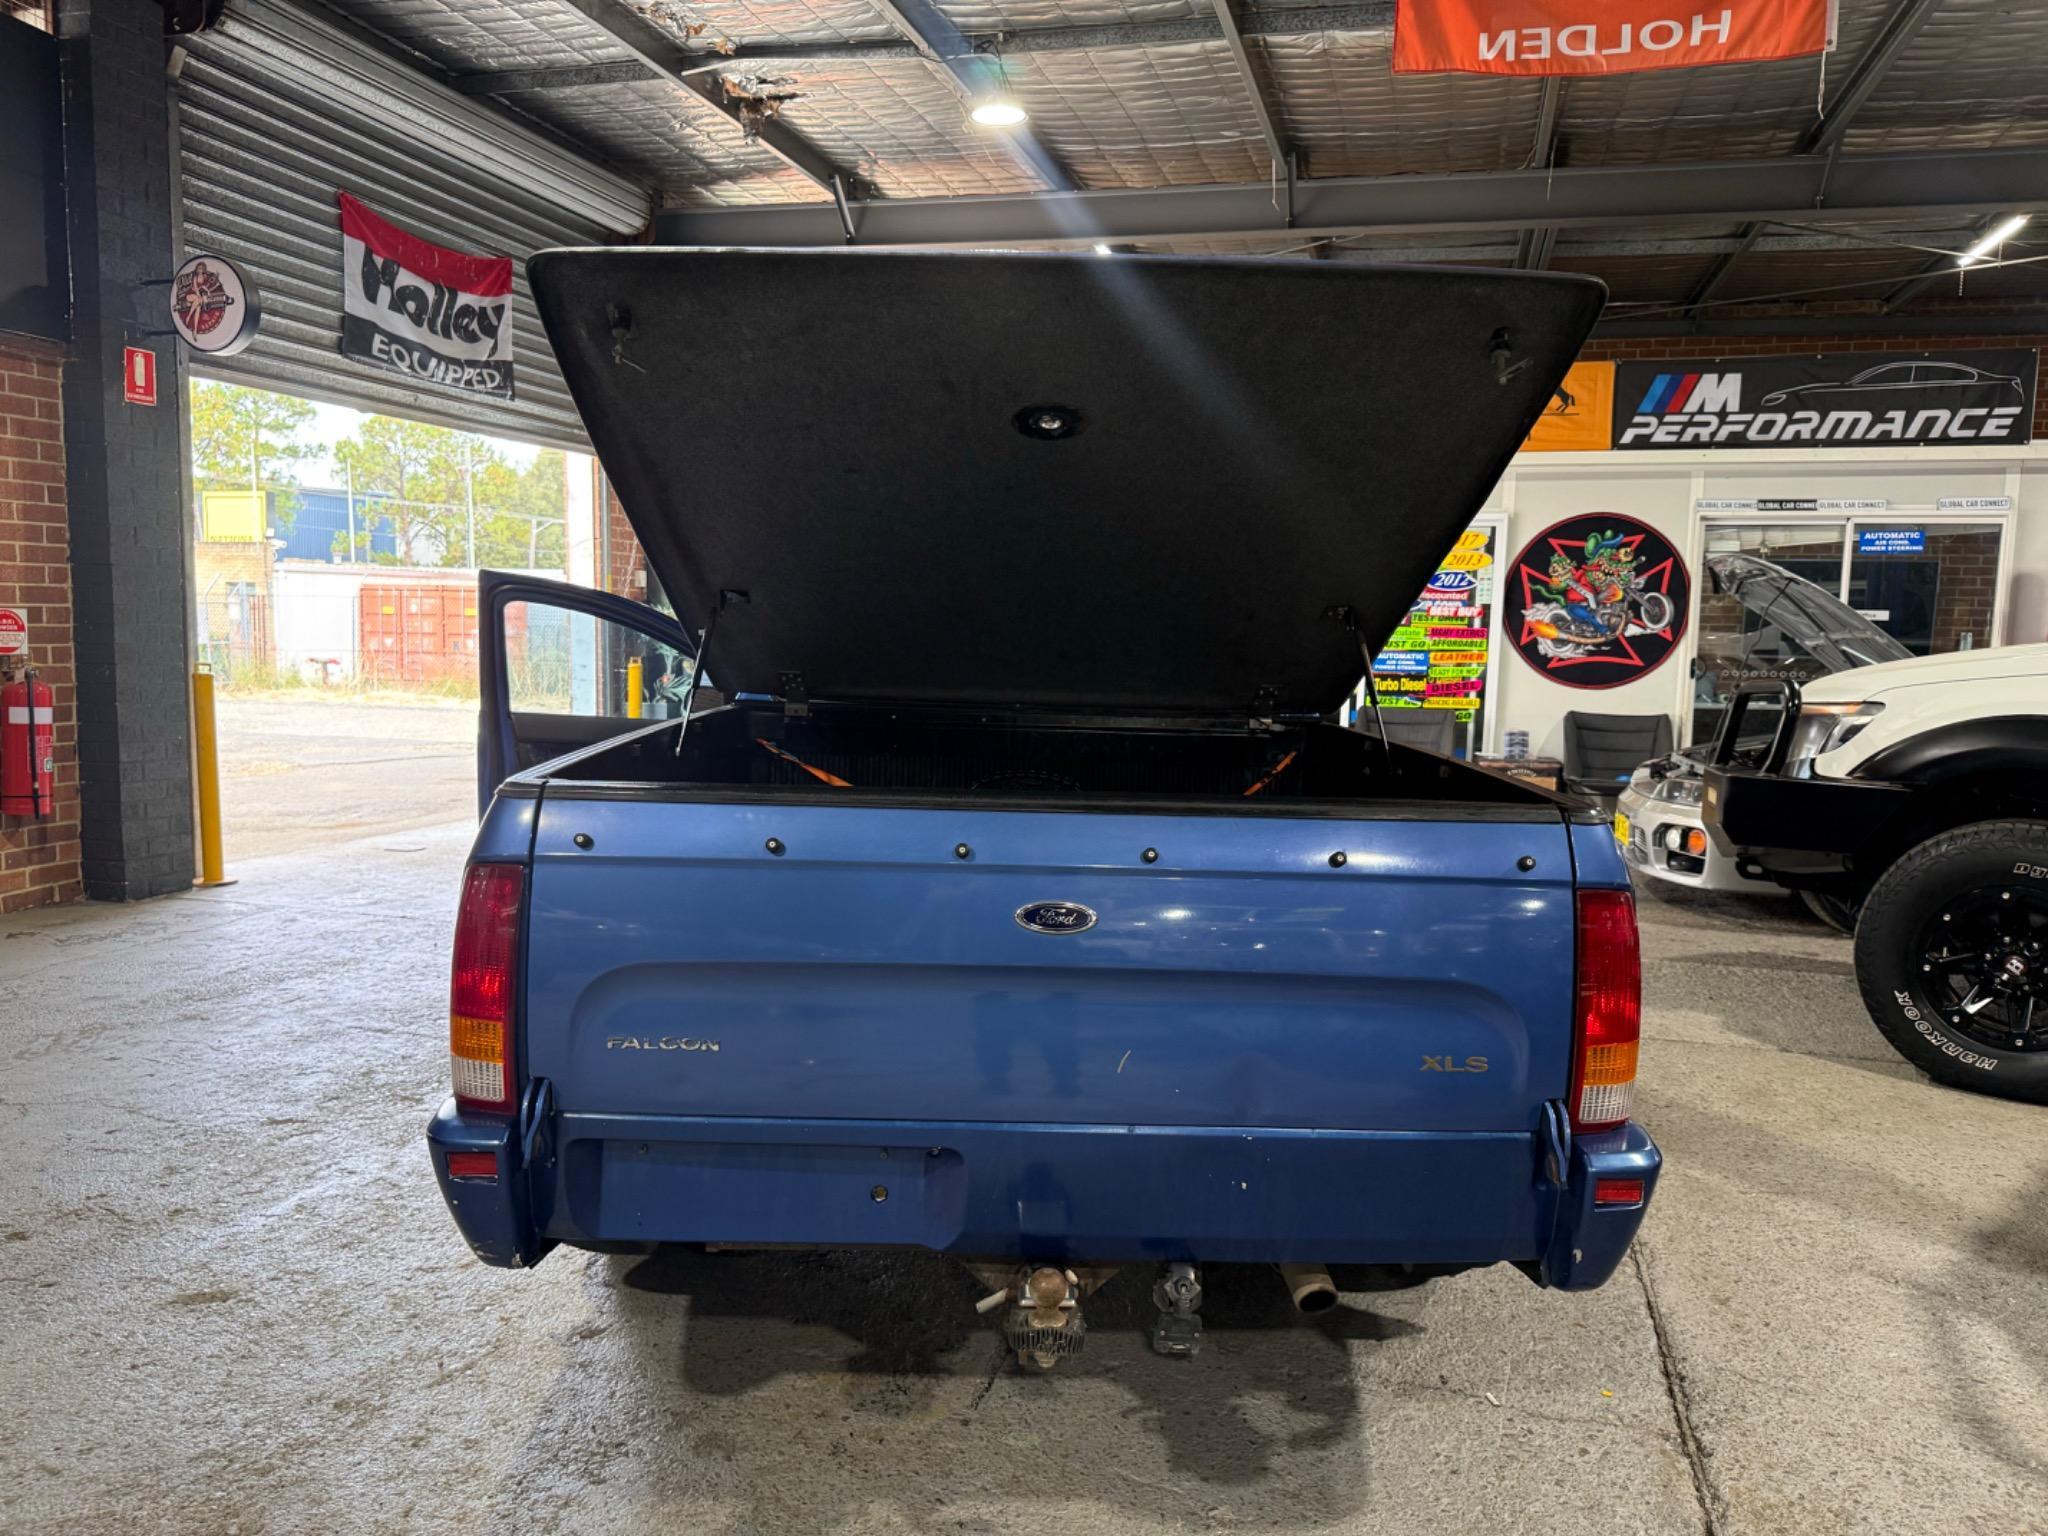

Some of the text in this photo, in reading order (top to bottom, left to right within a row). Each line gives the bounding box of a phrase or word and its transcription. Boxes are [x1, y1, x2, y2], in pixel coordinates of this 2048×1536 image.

[362, 243, 505, 360] Holley
[371, 332, 500, 389] EQUIPPED
[1619, 406, 2023, 444] PERFORMANCE
[1940, 499, 2009, 508] GLOBAL CAR CONNECT
[1461, 534, 1479, 546] 17
[1864, 531, 1920, 540] AUTOMATIC
[1447, 555, 1484, 566] 2013
[1435, 573, 1470, 586] 2012
[1429, 607, 1481, 616] BEST BUY
[1431, 628, 1486, 638] MANY EXTRAS
[1410, 640, 1426, 648] GO
[1431, 639, 1485, 648] AFFORDABLE
[1433, 653, 1485, 661] LEATHER
[1374, 678, 1399, 691] Turbo
[1400, 677, 1427, 691] Diesel
[1431, 681, 1477, 690] DIESEL
[1035, 907, 1077, 926] Ford
[606, 1036, 721, 1053] FALCON
[1420, 1055, 1489, 1073] XLS
